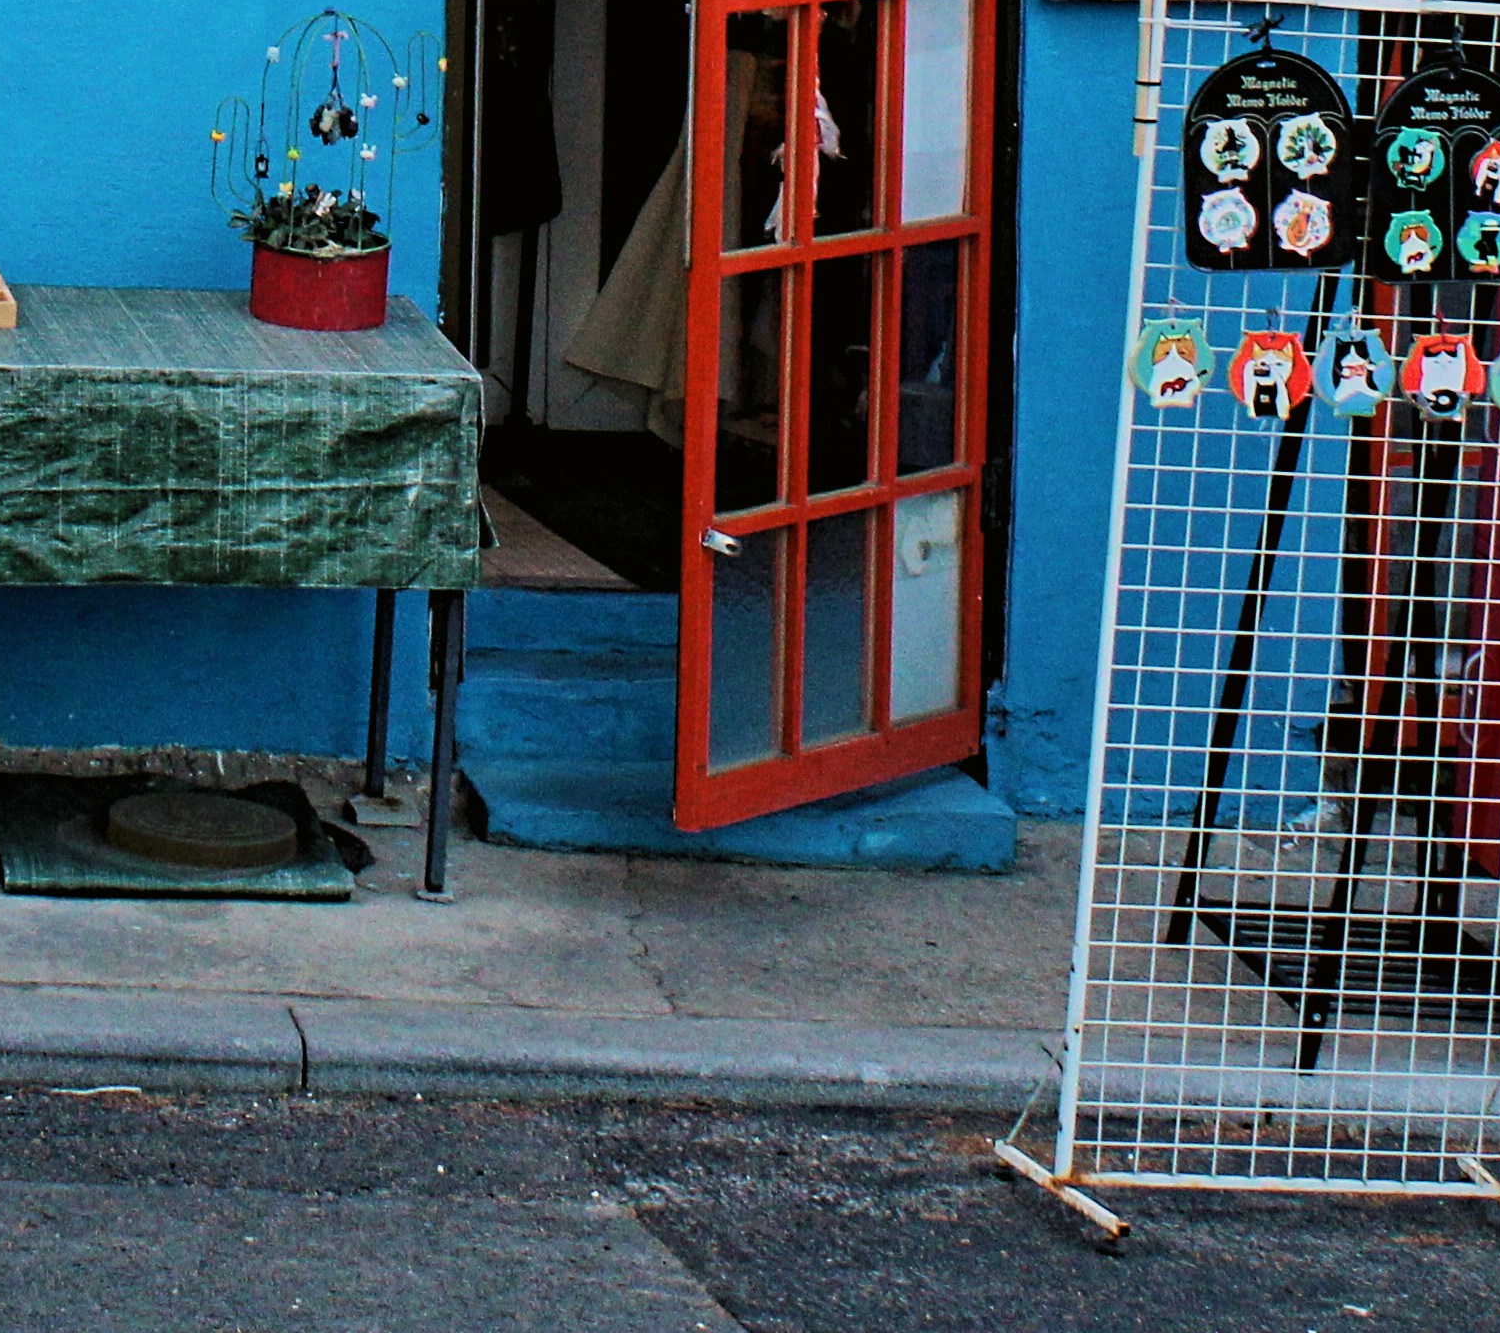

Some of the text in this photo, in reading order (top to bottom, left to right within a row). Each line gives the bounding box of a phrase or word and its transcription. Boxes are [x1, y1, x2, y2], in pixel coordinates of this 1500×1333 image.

[1240, 75, 1298, 90] Magnetic
[1226, 93, 1309, 108] Memo Holder
[1424, 88, 1481, 103] Magnetic
[1410, 106, 1492, 120] Memo Holder
